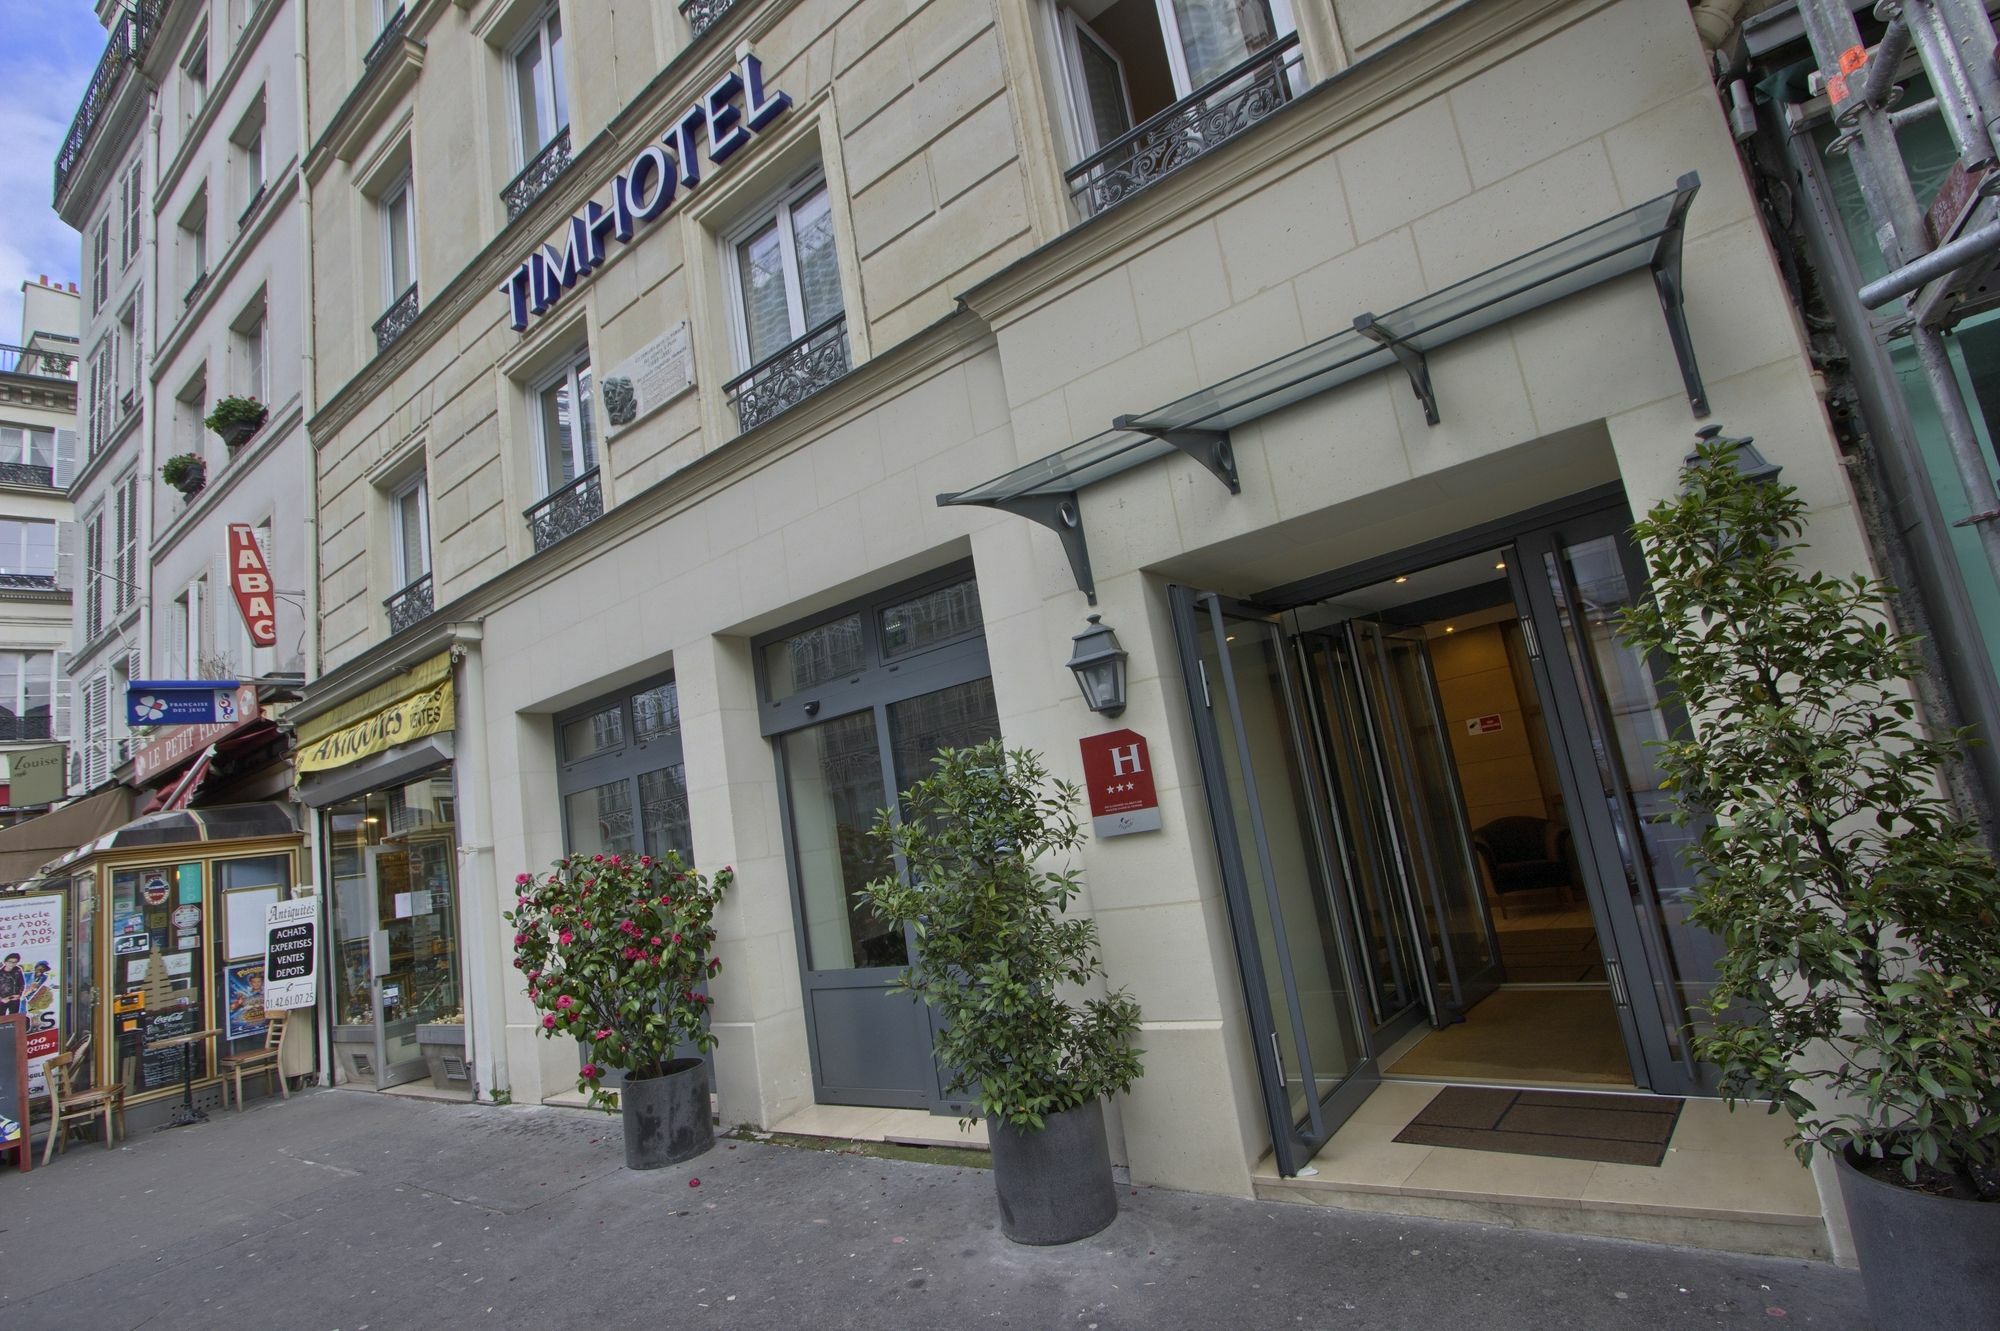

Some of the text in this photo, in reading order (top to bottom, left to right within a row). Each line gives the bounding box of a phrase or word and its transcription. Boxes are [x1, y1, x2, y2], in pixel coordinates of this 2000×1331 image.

[499, 53, 793, 332] TIMHOTEL
[232, 526, 275, 640] TABAC
[148, 723, 230, 770] LE PETIT FLO
[14, 755, 58, 770] Louise
[1108, 743, 1145, 777] H
[268, 904, 315, 922] Antiquités
[17, 919, 51, 928] ADOS,
[22, 927, 55, 937] ADOS,
[276, 926, 307, 939] ACHATS
[21, 936, 51, 946] ADOS
[270, 938, 313, 953] EXPERTISES
[276, 953, 305, 965] VENTES
[275, 966, 305, 978] DEPOTS
[265, 992, 314, 1009] 01.42.61.07.25
